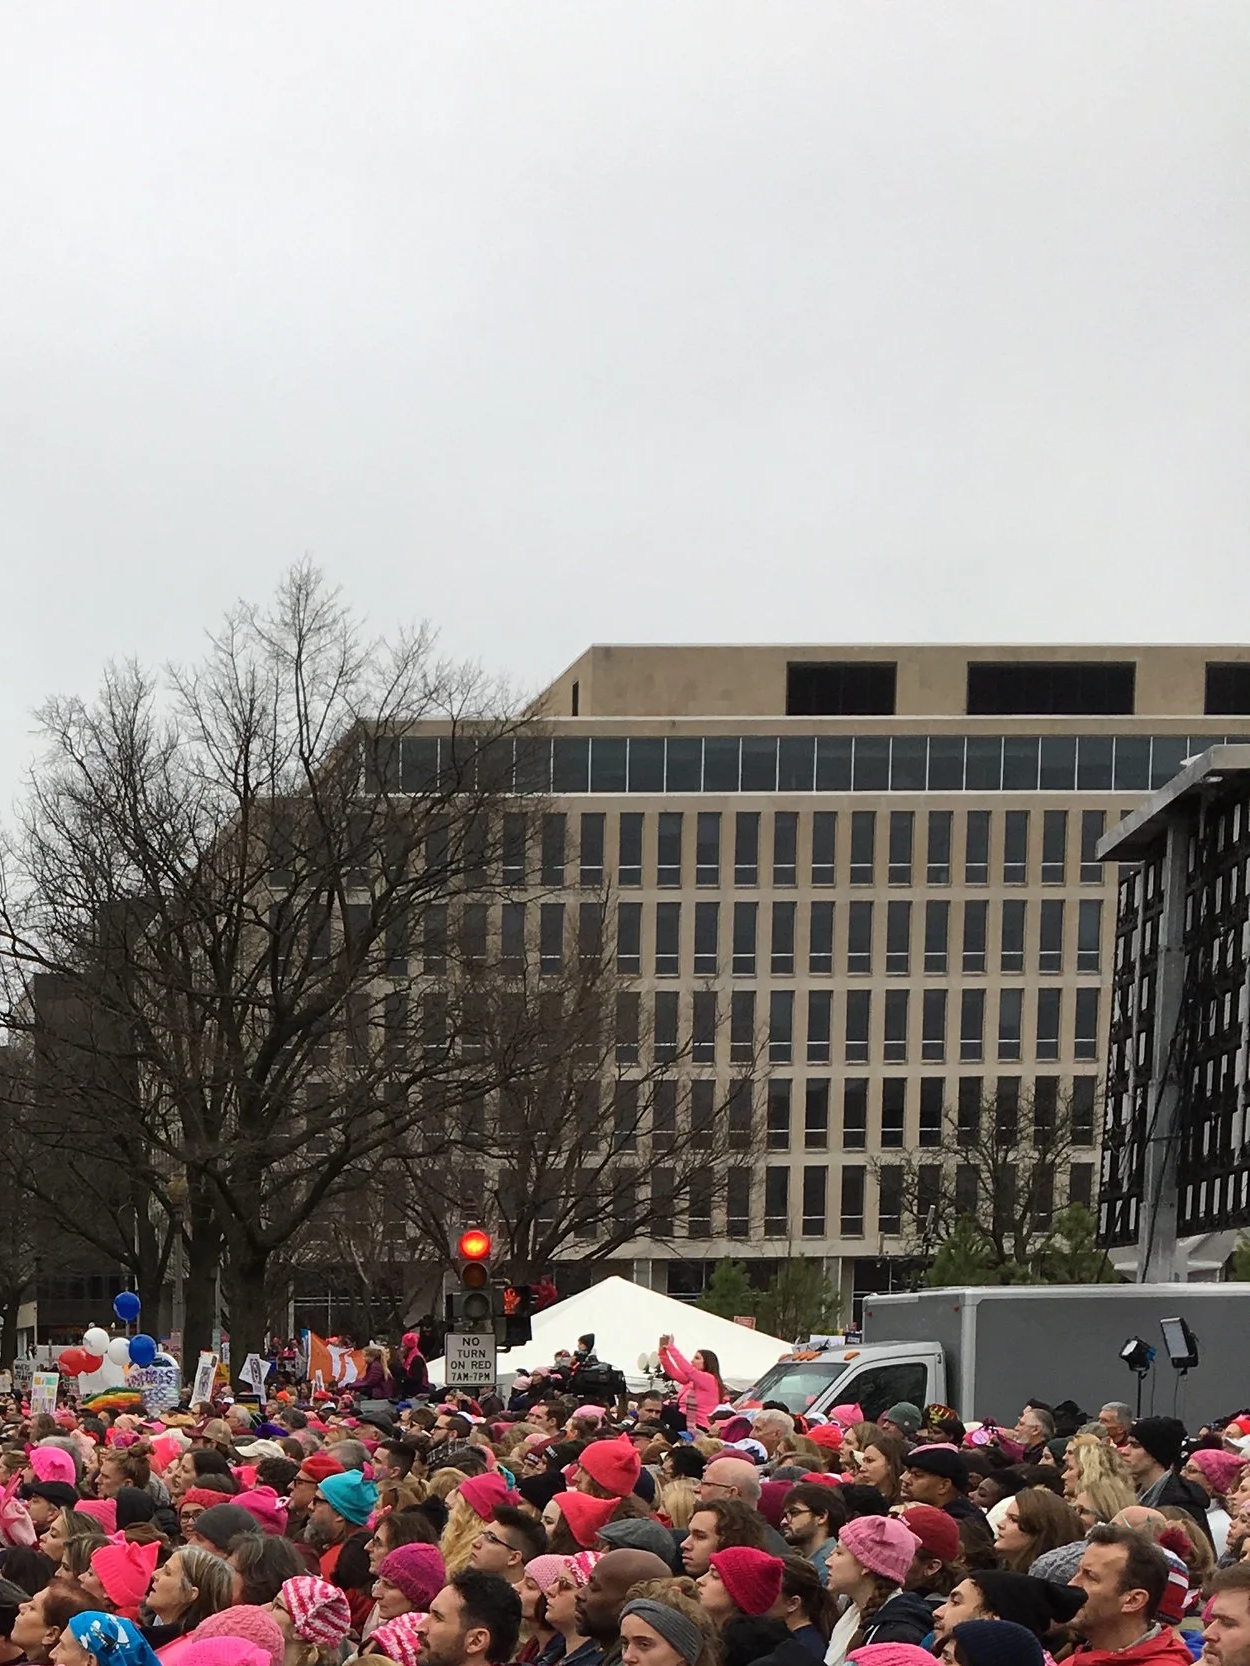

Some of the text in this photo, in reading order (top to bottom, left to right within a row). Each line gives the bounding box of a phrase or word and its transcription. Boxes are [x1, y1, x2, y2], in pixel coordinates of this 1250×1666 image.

[462, 1337, 480, 1346] NO
[457, 1350, 486, 1358] TURN
[451, 1361, 491, 1369] ON RED
[452, 1372, 490, 1381] 7AM-7PM
